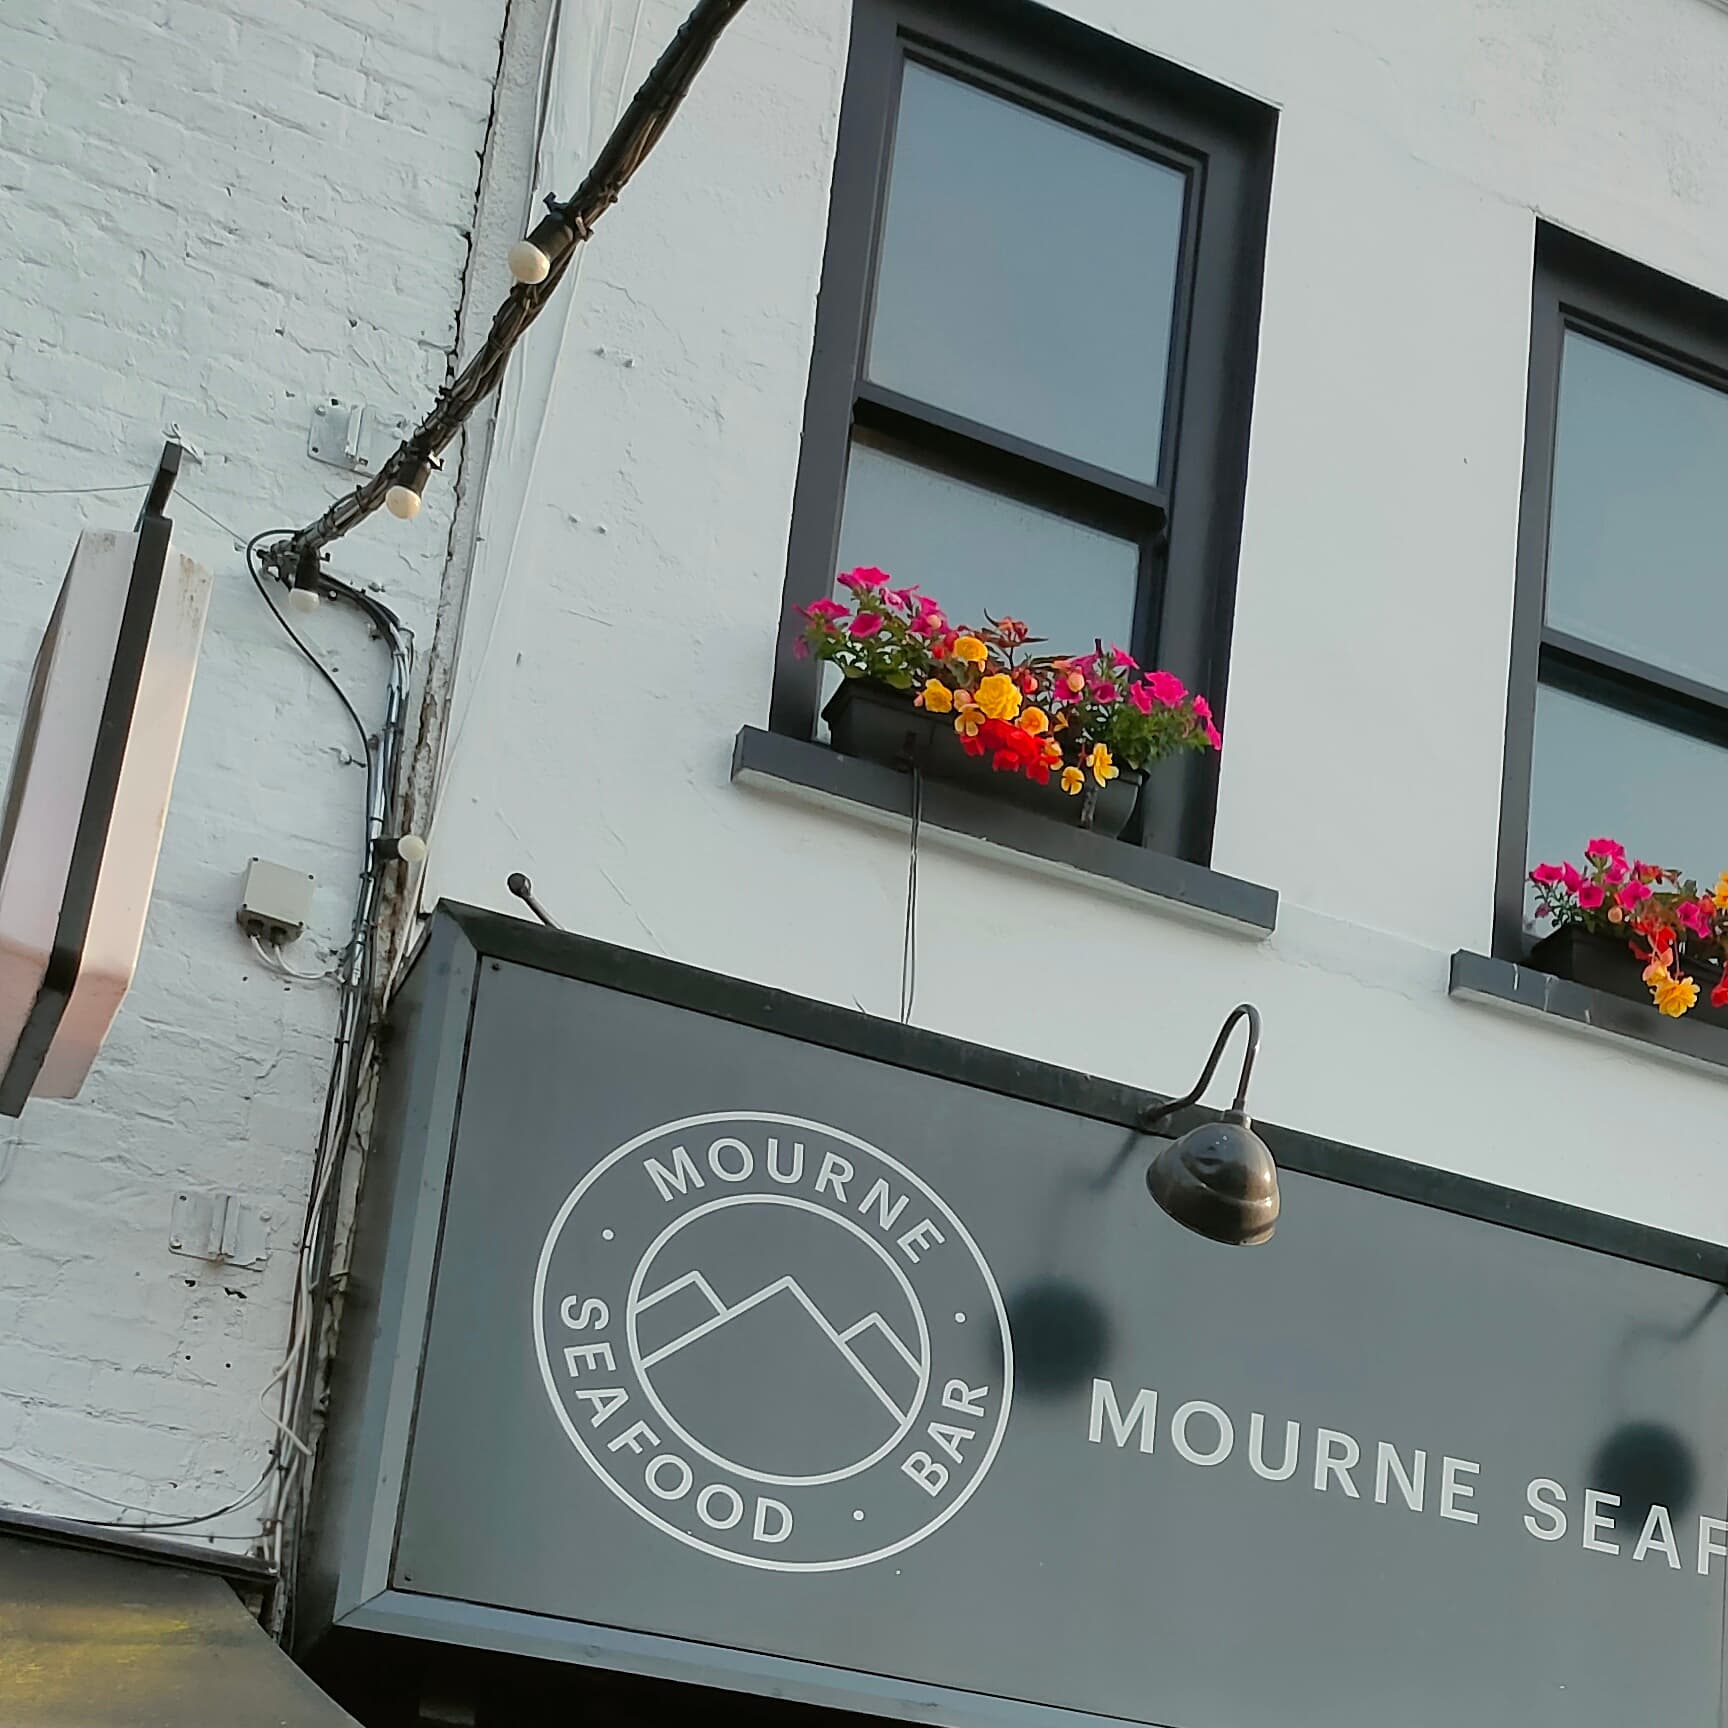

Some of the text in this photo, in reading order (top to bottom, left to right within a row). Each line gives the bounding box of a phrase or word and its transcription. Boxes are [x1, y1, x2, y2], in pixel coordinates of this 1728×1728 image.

[643, 1137, 945, 1264] MOURNE
[560, 1294, 793, 1543] SEAFOOD
[901, 1378, 989, 1497] BAR
[1088, 1377, 1480, 1524] MOURNE
